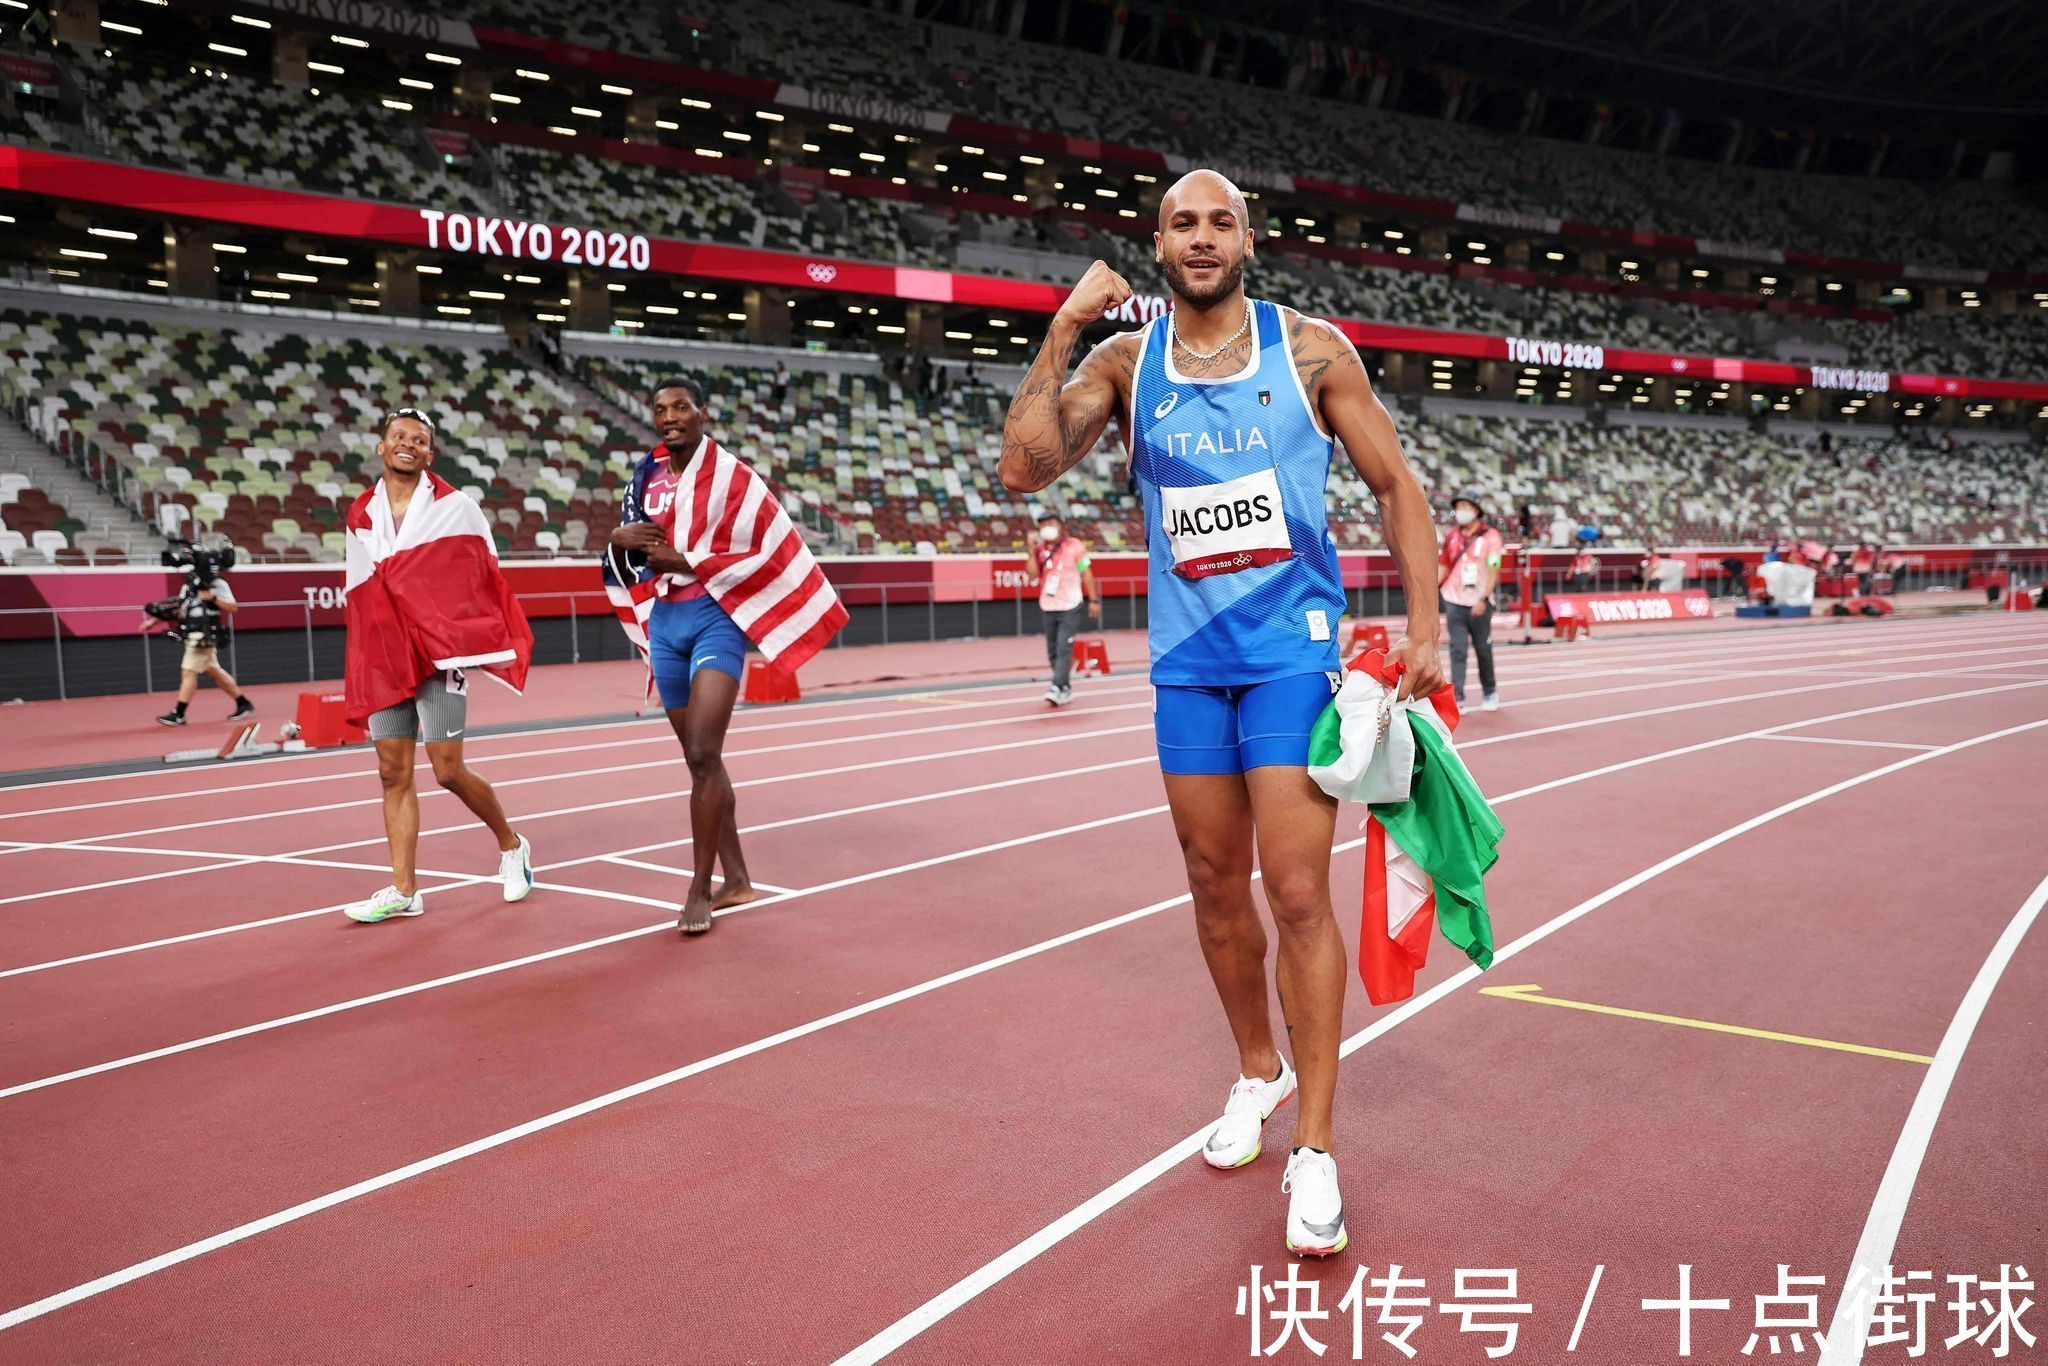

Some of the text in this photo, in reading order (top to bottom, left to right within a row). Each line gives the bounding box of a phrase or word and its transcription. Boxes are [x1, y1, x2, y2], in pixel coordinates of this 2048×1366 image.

[371, 3, 440, 41] 2020
[420, 208, 650, 271] TOKYO 2020
[1506, 337, 1604, 370] TOKYO 2020
[1810, 366, 1890, 392] TOKYO 2020
[1167, 426, 1269, 458] ITALIA
[1170, 495, 1272, 537] JACOBS
[1196, 560, 1232, 571] TOKYO 2020
[1588, 598, 1673, 622] TOKYO 2020
